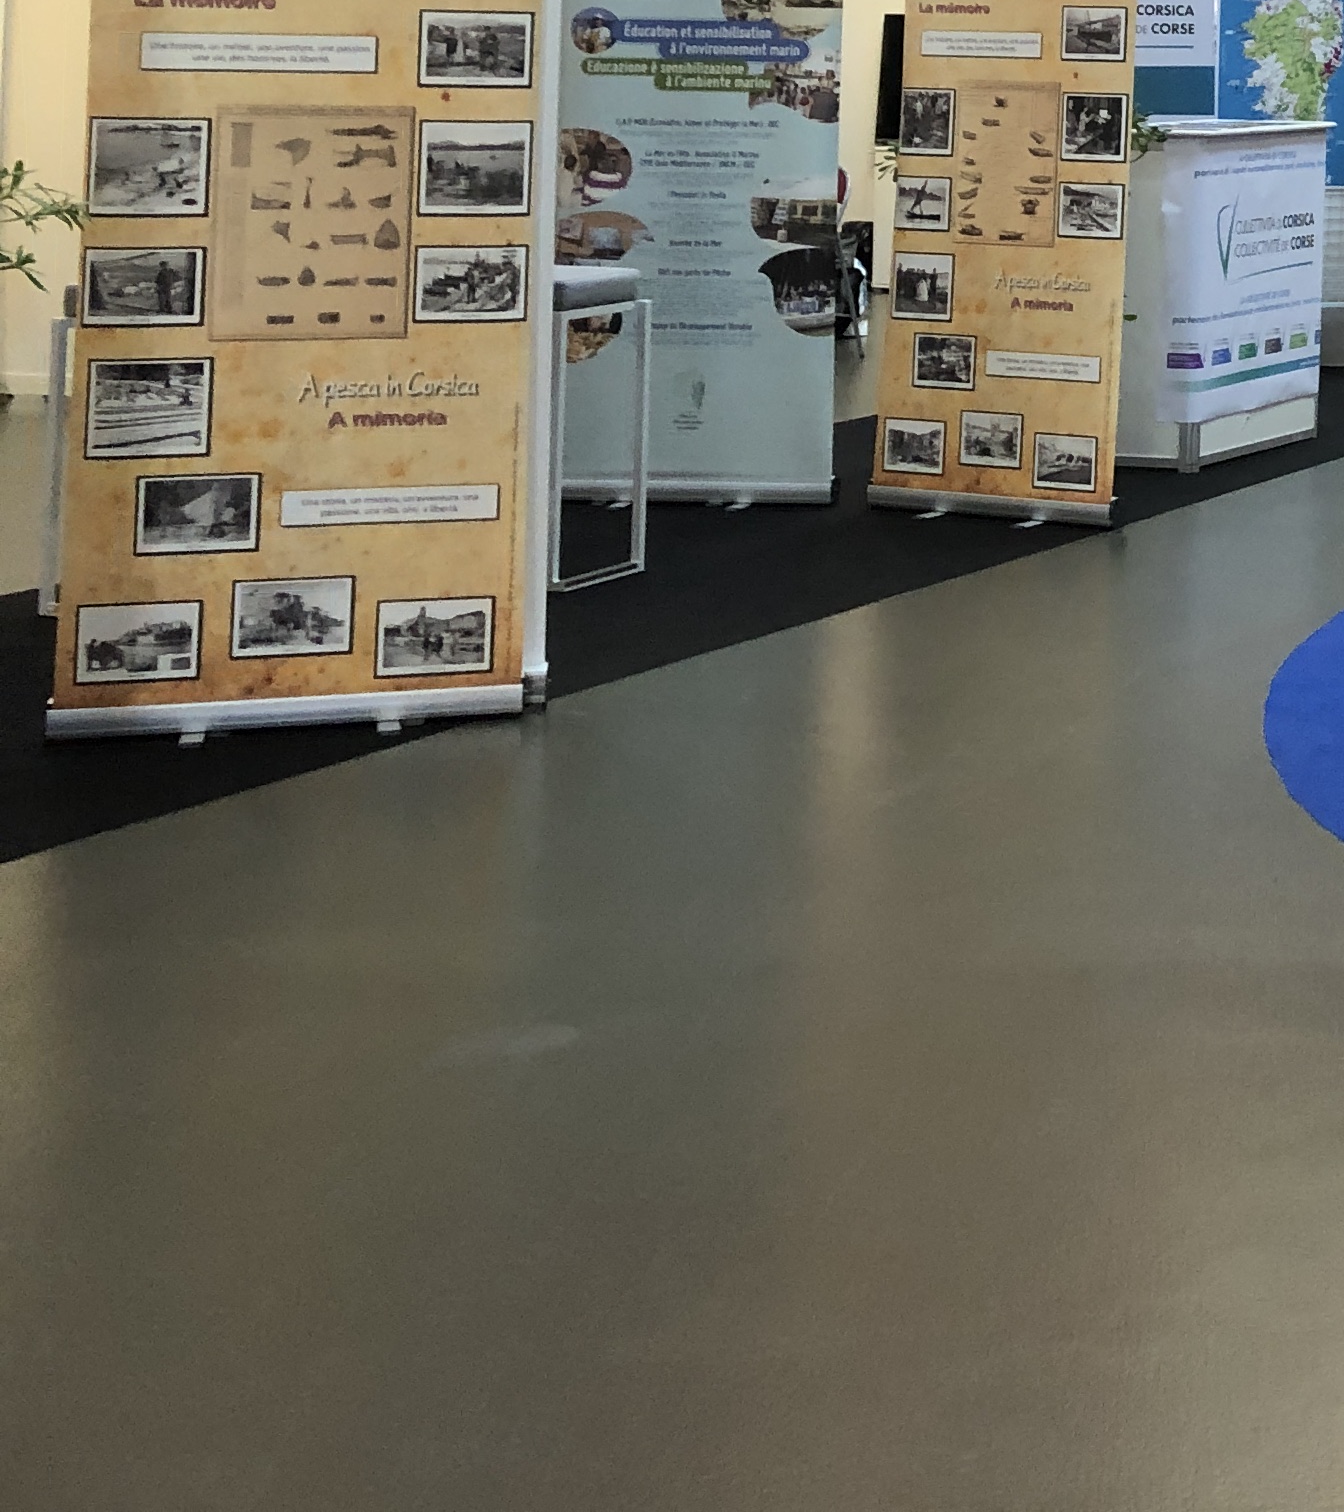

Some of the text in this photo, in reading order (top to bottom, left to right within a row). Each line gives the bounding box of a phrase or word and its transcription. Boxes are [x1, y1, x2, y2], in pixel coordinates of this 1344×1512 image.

[1137, 4, 1195, 17] CORSICA
[624, 21, 678, 39] Éducation
[680, 26, 693, 39] et
[1151, 22, 1195, 35] CORSE
[769, 44, 800, 56] marin
[1290, 234, 1315, 251] CORSE
[299, 373, 320, 403] A
[387, 374, 402, 398] in
[328, 411, 348, 429] A
